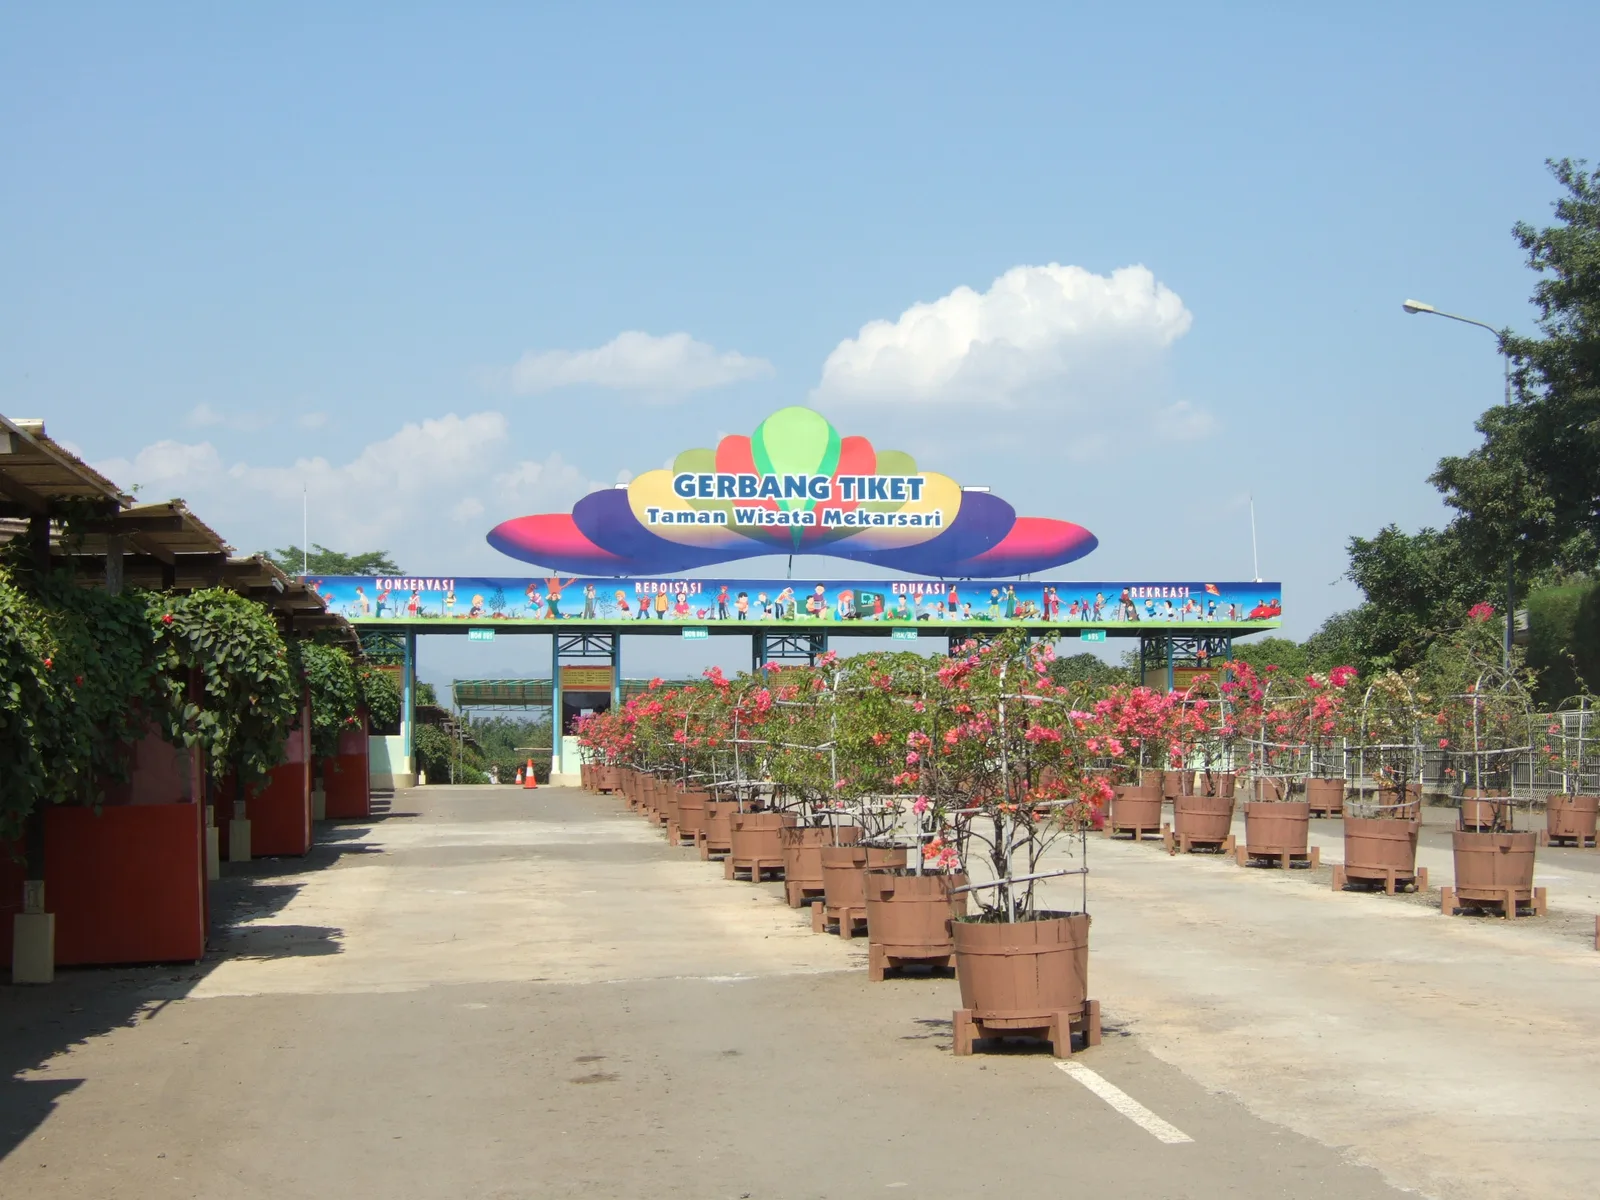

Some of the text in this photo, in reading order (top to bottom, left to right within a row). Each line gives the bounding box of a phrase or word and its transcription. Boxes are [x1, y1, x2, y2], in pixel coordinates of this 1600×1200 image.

[672, 473, 925, 501] GERBANG TIKET
[647, 508, 942, 528] Taman Wisata Mekarsari
[375, 579, 454, 591] KONSERVASI
[635, 582, 702, 594] REBOISASI
[892, 583, 946, 595] EDUKASI
[1131, 586, 1189, 598] REKREASI
